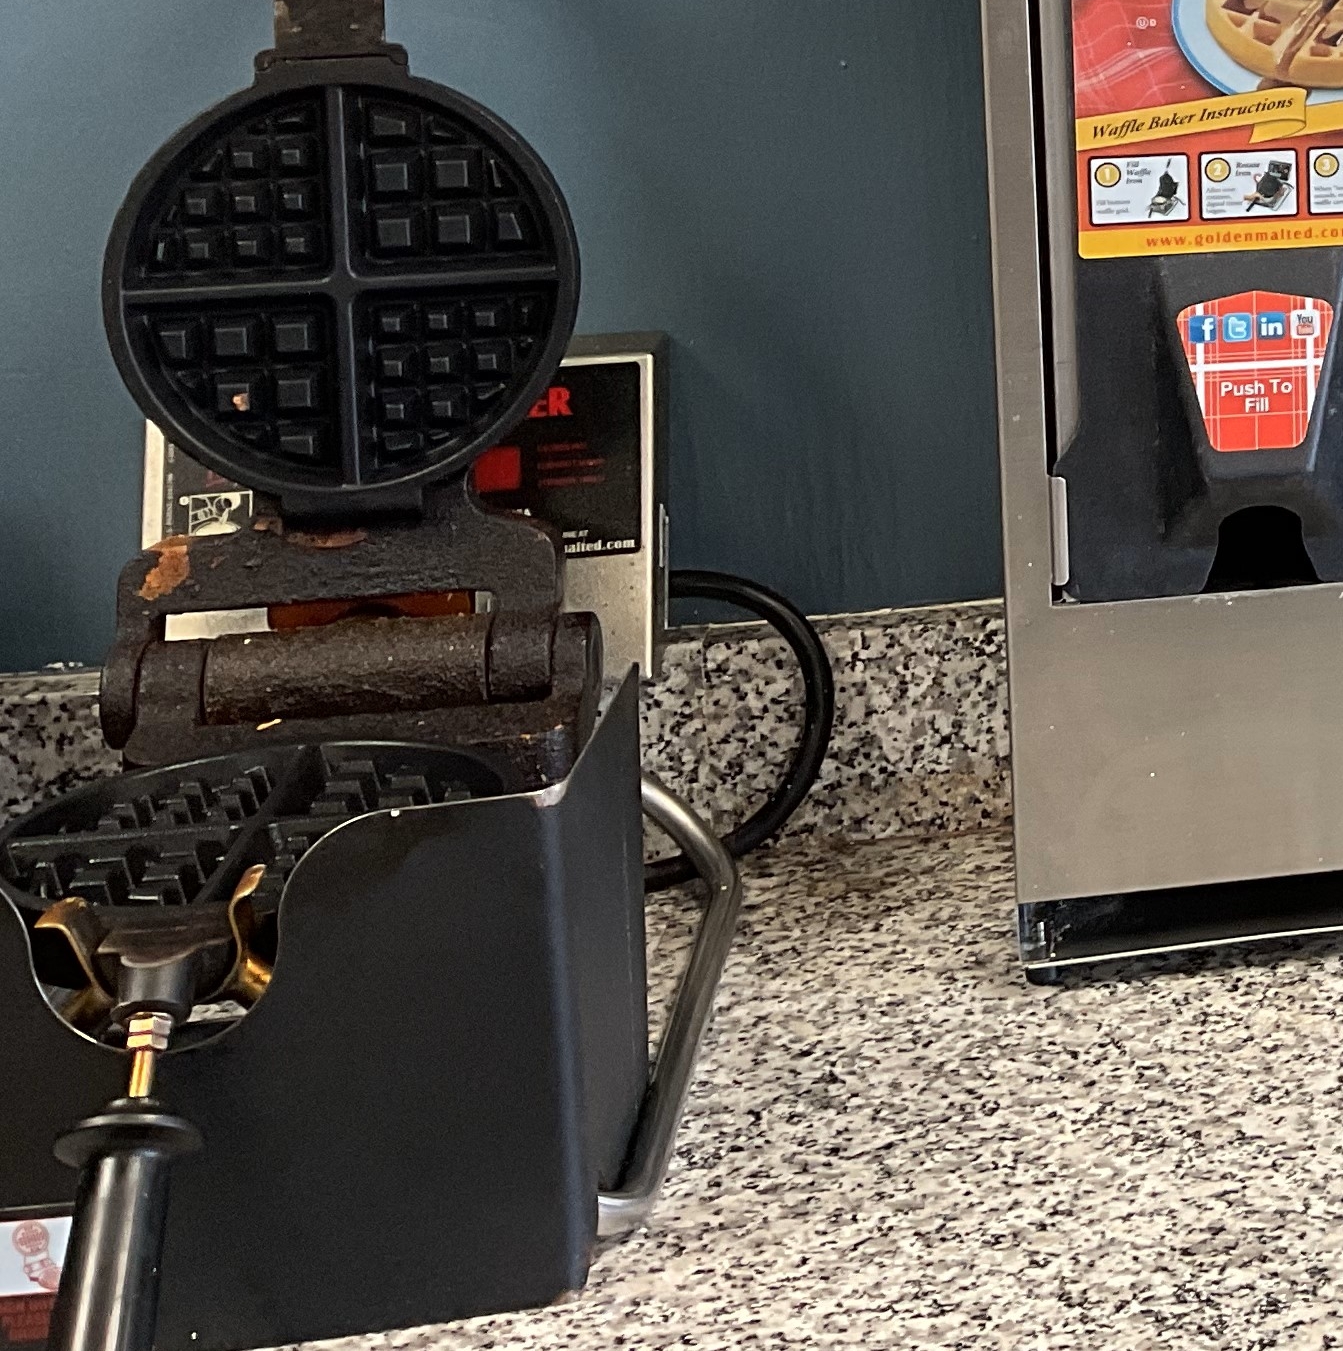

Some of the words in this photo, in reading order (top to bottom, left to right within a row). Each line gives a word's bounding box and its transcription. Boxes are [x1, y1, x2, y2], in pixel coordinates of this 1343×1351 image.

[1092, 118, 1146, 140] Waffle
[1148, 111, 1197, 131] Baker
[1198, 97, 1295, 122] Instructions
[1220, 379, 1265, 397] Push
[1269, 378, 1293, 394] To
[1244, 397, 1270, 413] Fill
